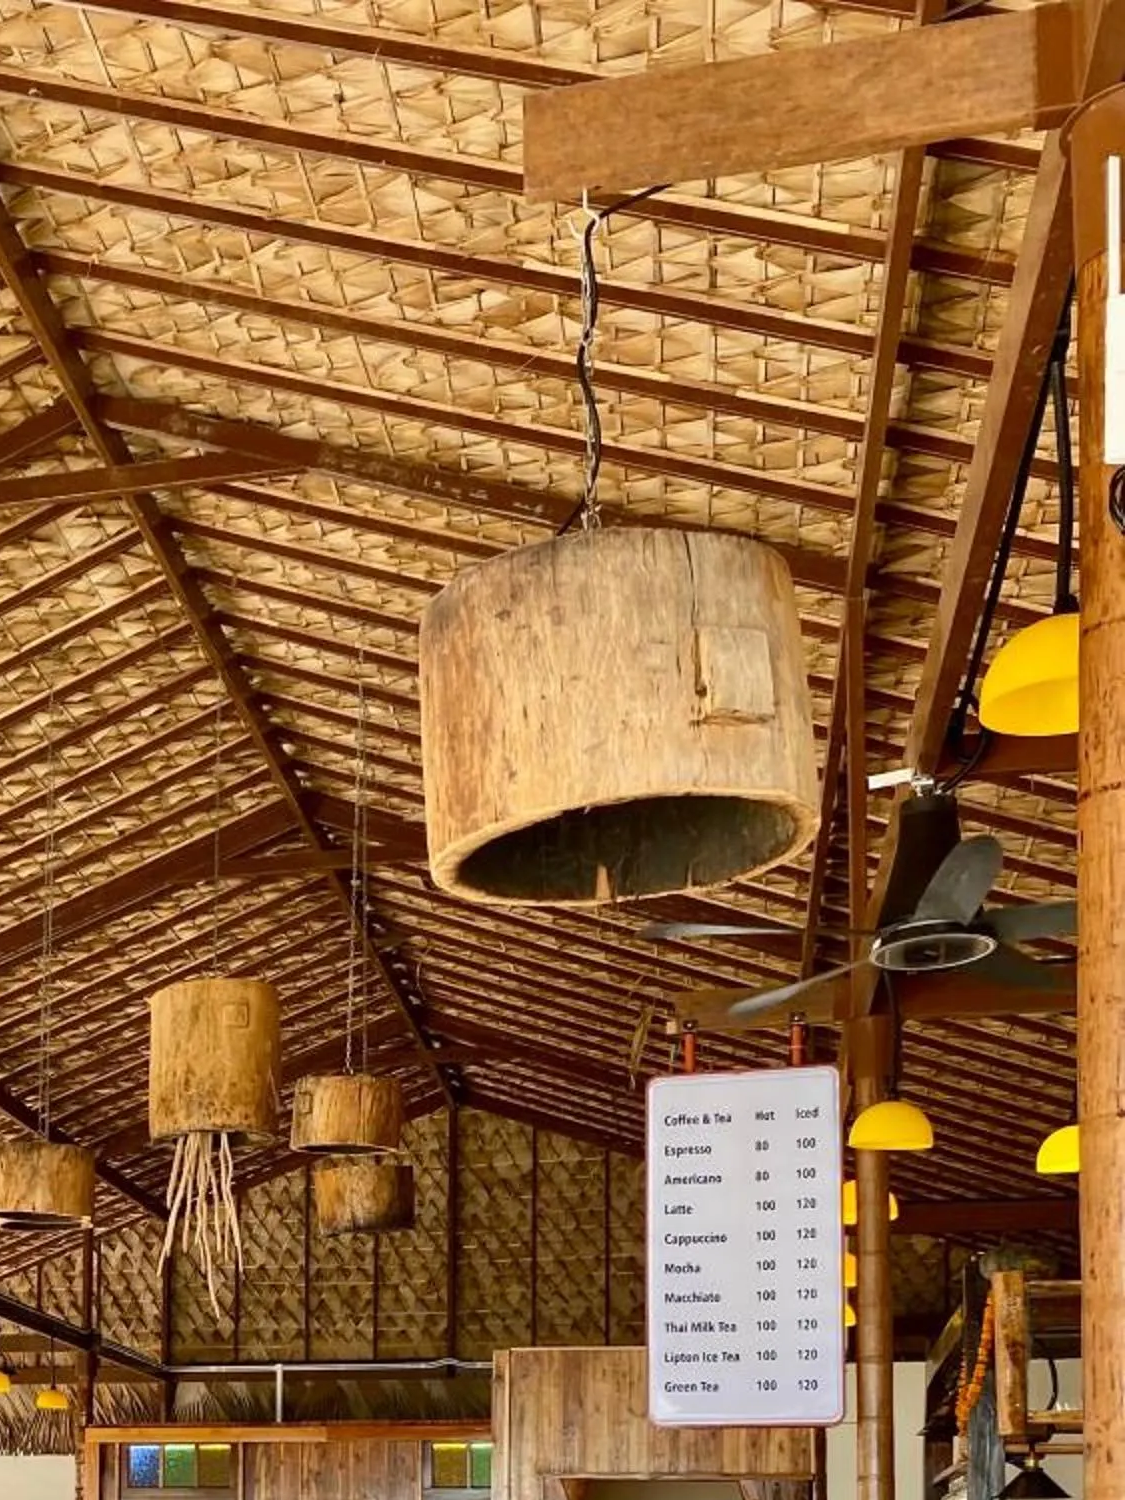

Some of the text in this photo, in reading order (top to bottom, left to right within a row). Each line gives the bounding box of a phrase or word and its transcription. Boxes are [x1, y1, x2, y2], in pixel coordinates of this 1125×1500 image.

[664, 1106, 820, 1127] Coffee & Tea Hot Iced
[664, 1137, 817, 1159] Espresso 80 100
[664, 1167, 817, 1185] Americano 80 100
[664, 1197, 817, 1216] Latte 100 120
[664, 1227, 817, 1247] Cappuccino 100 120
[664, 1257, 818, 1275] Mocha 100 120
[664, 1287, 818, 1304] Macchiato 100 120
[664, 1318, 818, 1334] Thai Milk Tea 100 120
[664, 1348, 818, 1366] Lipton Ice Tea 100 120
[664, 1378, 819, 1393] Green Tea 100 120
